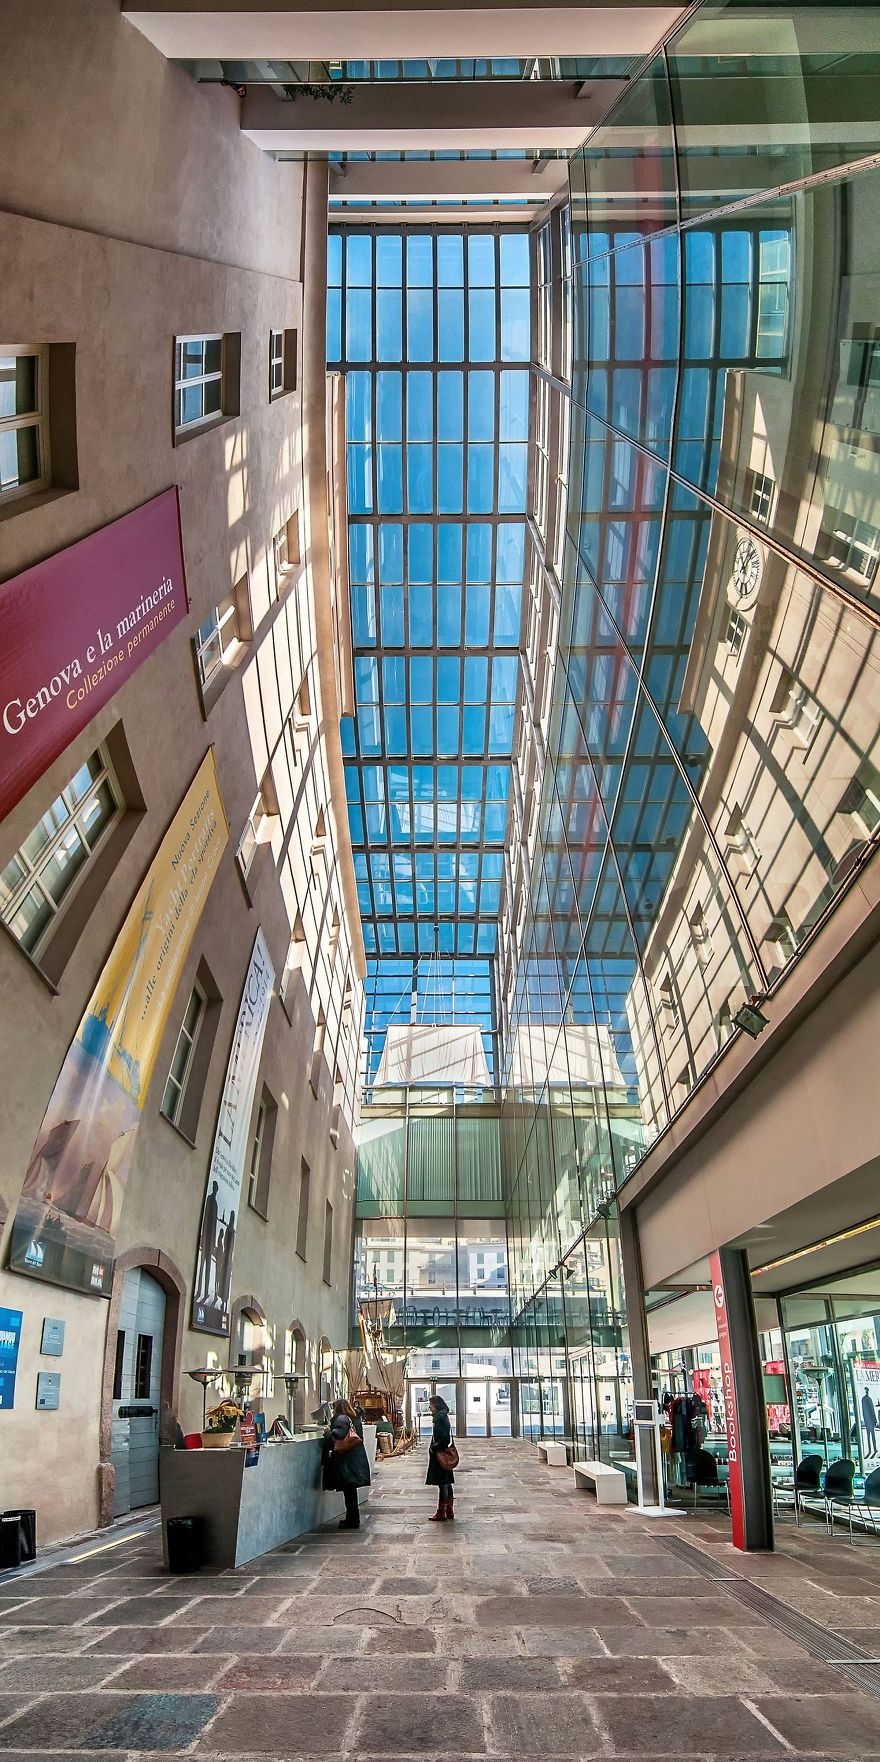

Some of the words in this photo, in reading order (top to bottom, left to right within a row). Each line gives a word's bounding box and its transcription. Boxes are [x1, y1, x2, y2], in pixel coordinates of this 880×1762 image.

[3, 658, 83, 735] Genova
[86, 645, 96, 664] e
[96, 628, 113, 656] la
[116, 576, 174, 639] marineria
[66, 649, 124, 709] Collezione
[127, 599, 176, 658] permanente
[171, 831, 191, 871] Nuova
[190, 790, 209, 831] Sezione
[724, 1362, 737, 1462] Bookshop
